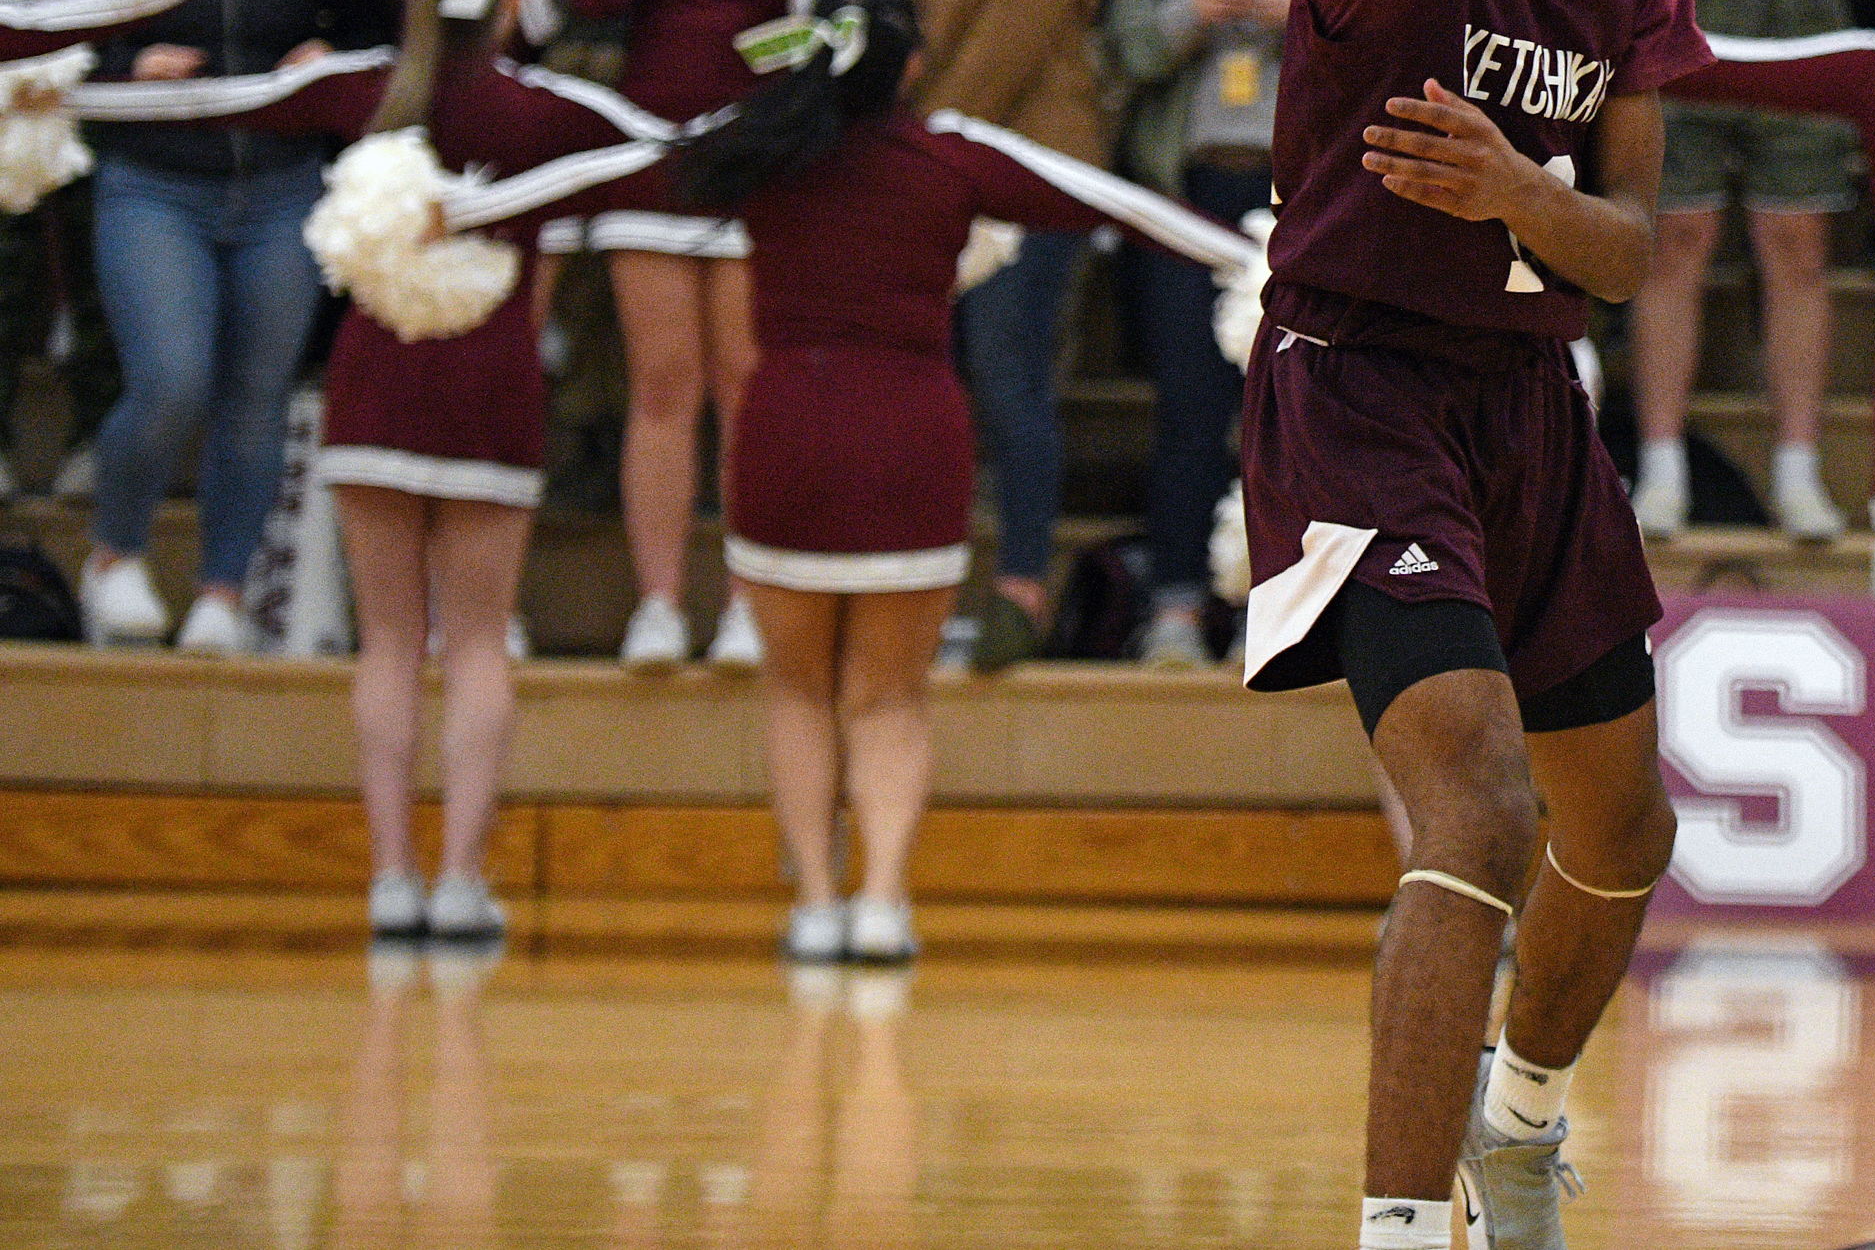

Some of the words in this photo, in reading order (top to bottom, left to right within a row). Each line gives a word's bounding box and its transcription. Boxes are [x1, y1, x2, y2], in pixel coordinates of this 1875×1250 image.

[1463, 23, 1616, 124] KETCHIKA
[1388, 560, 1440, 576] adidas
[1652, 607, 1868, 907] S
